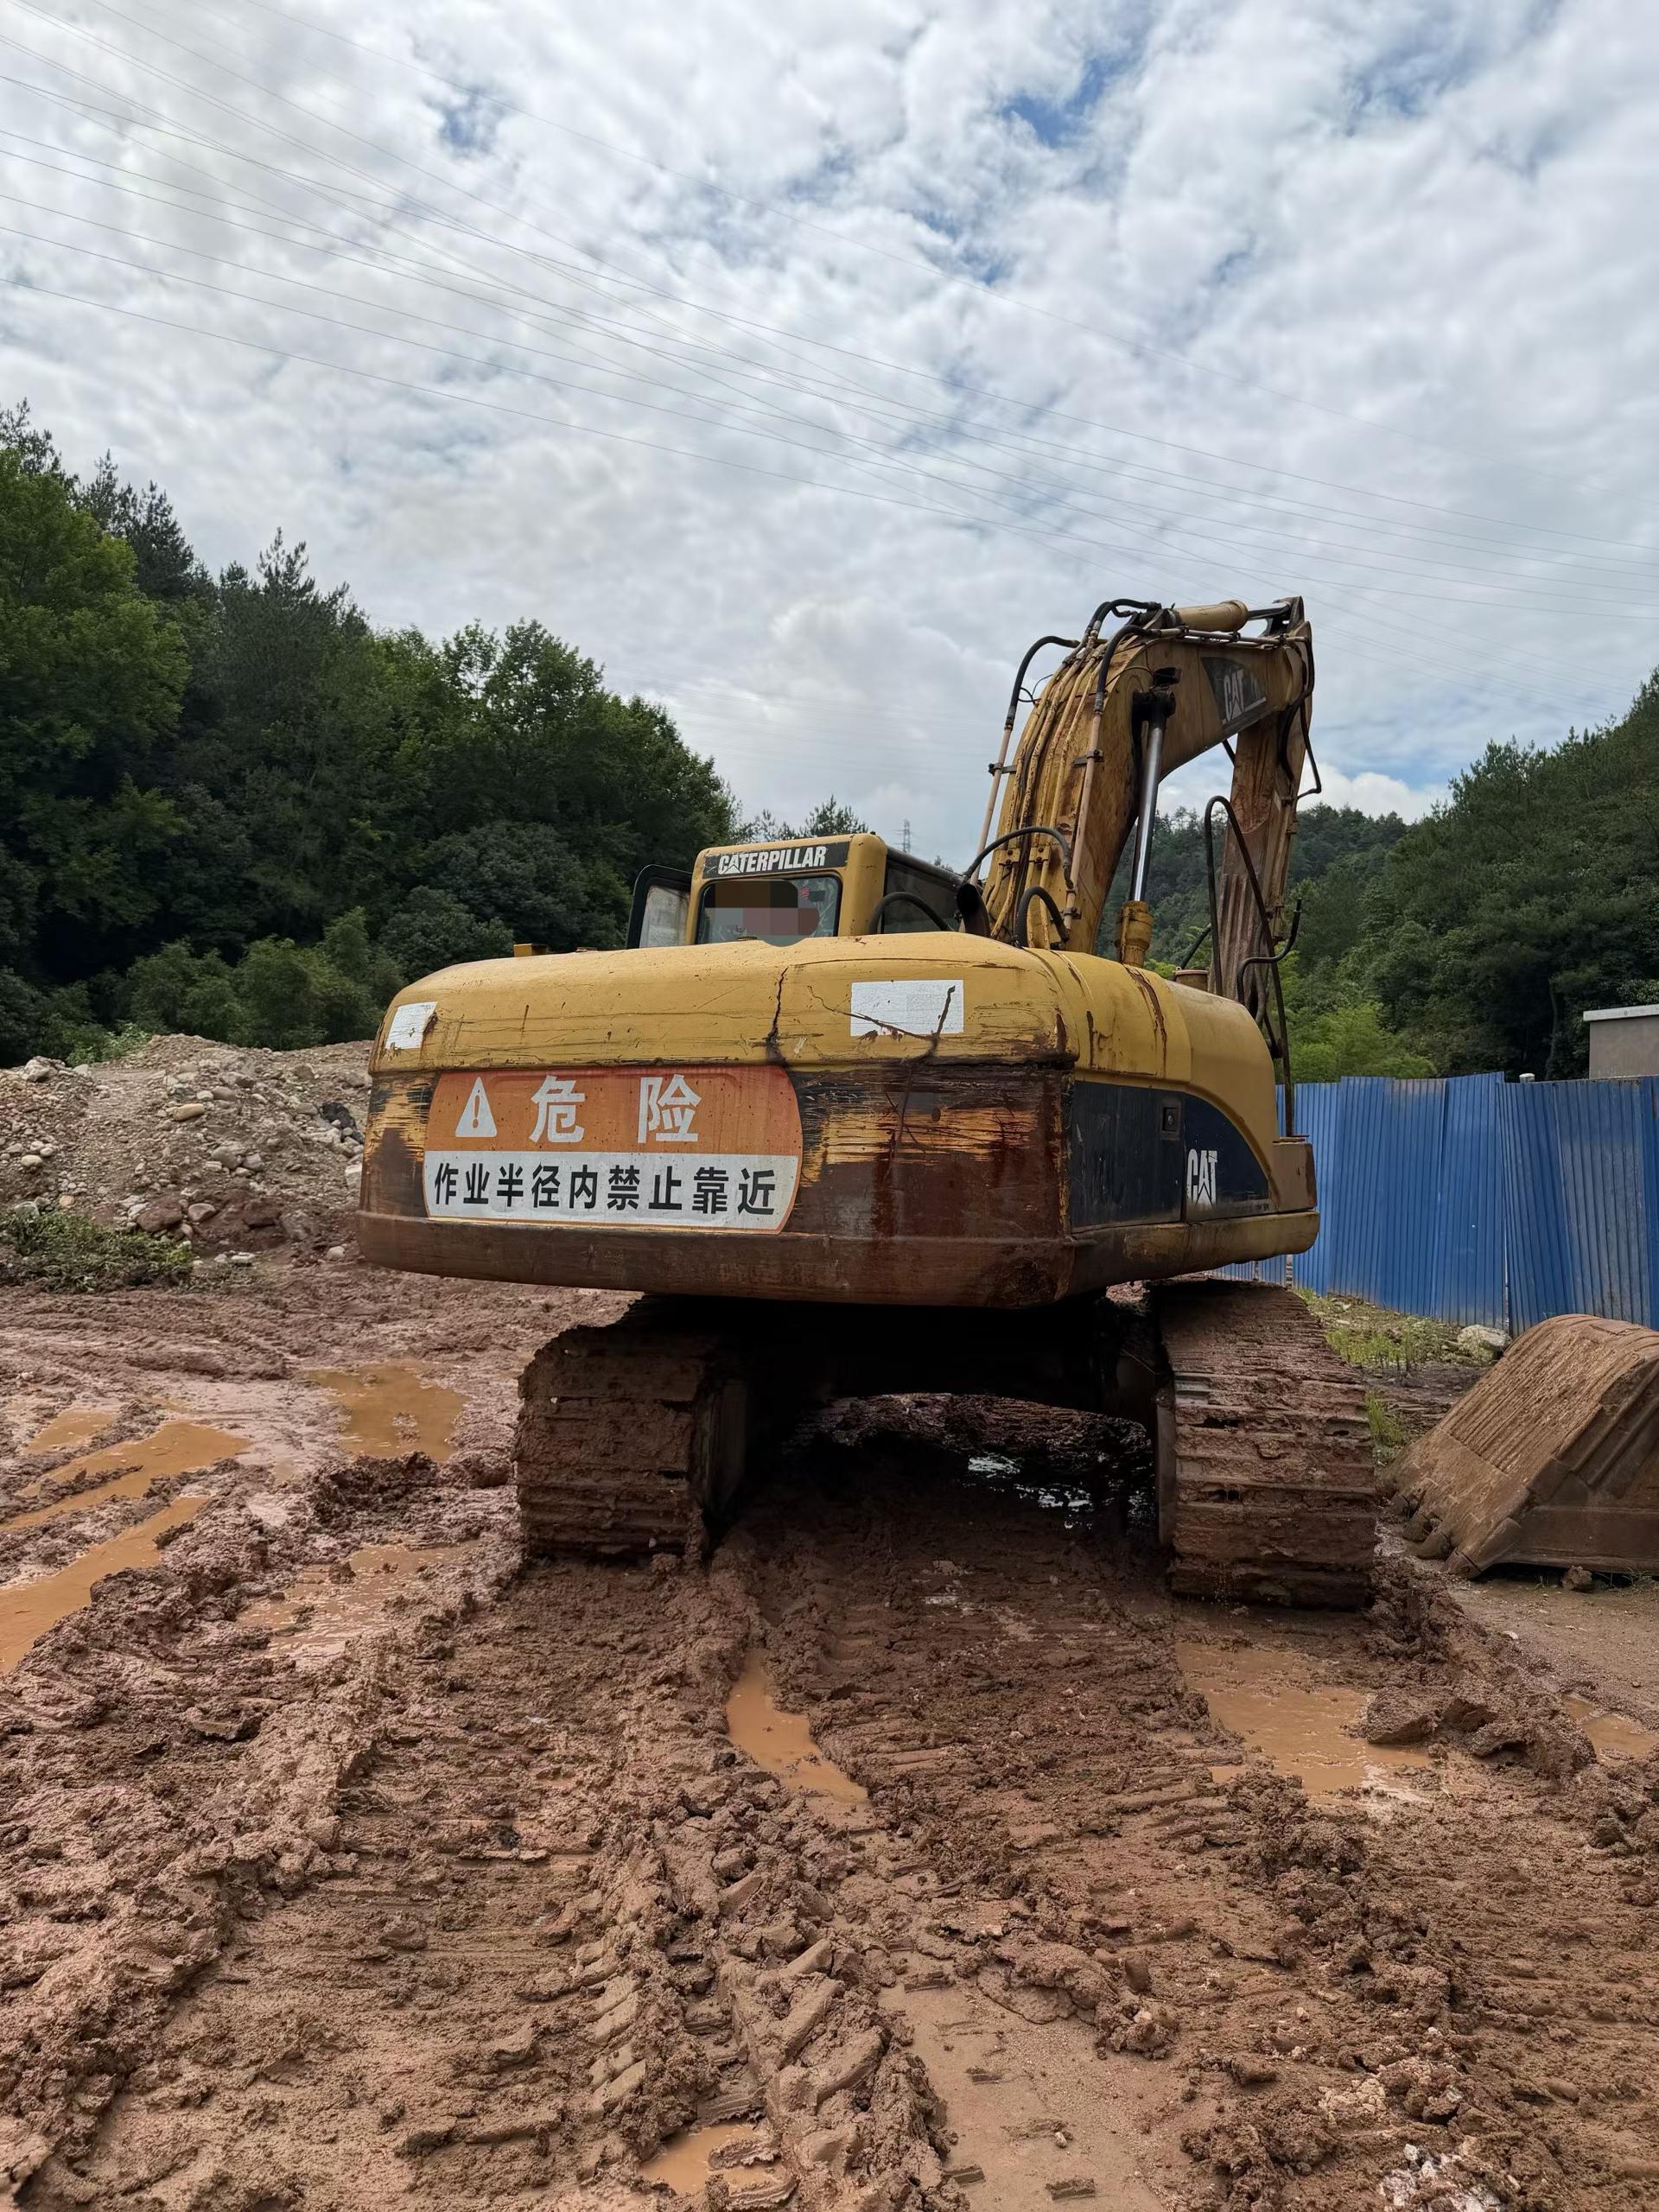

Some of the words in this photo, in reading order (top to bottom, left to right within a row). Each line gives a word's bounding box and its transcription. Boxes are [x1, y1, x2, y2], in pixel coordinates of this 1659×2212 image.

[1224, 669, 1244, 721] CAT
[718, 846, 826, 874] CATERPILLAR
[529, 1074, 702, 1144] 危险
[435, 1162, 776, 1215] 作业半径内禁止靠近
[1187, 1149, 1217, 1208] CAT
